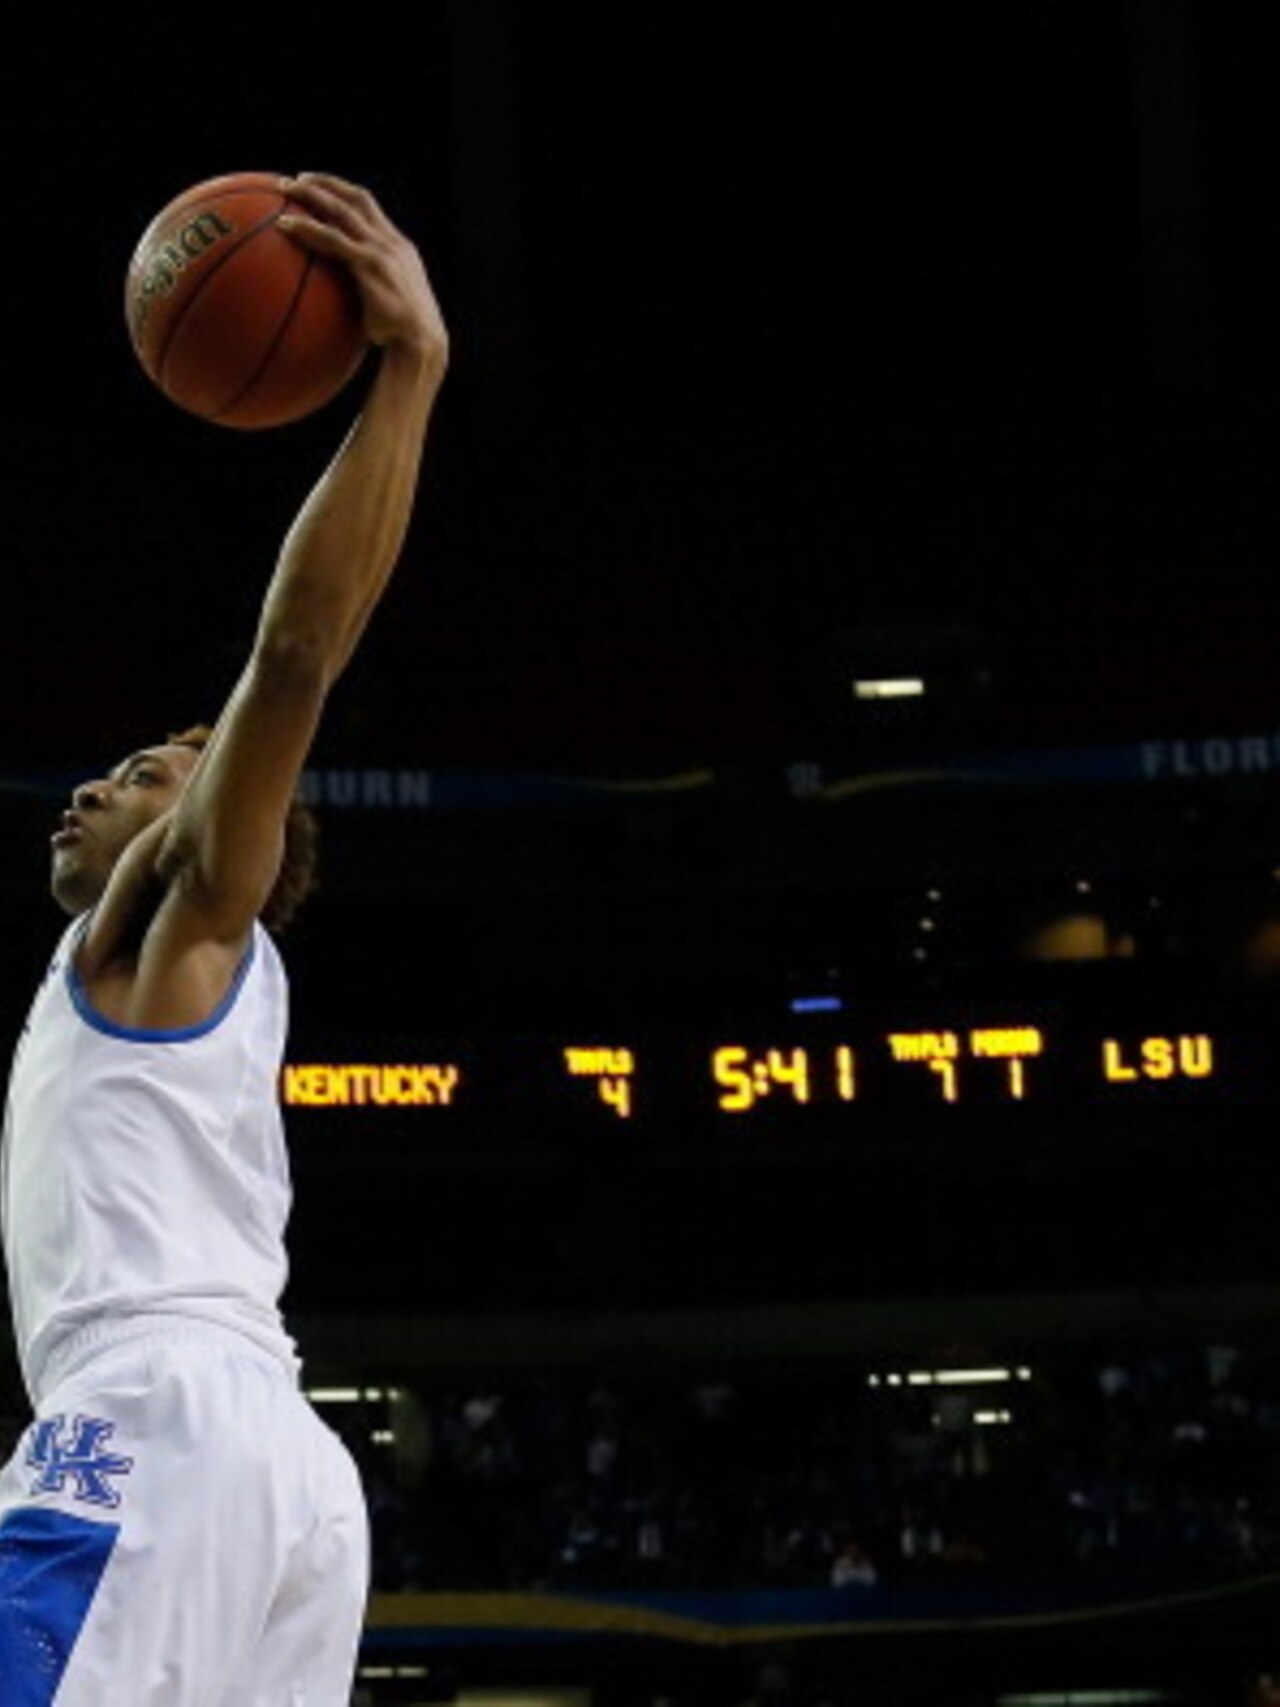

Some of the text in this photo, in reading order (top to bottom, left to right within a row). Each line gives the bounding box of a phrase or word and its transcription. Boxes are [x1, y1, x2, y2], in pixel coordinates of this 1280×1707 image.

[297, 769, 433, 808] BURN
[714, 1045, 854, 1112] 5:41
[1103, 1034, 1212, 1081] LSU
[284, 1064, 458, 1104] KENTUCKY
[599, 1076, 631, 1118] 4
[929, 1058, 1023, 1102] 7 1
